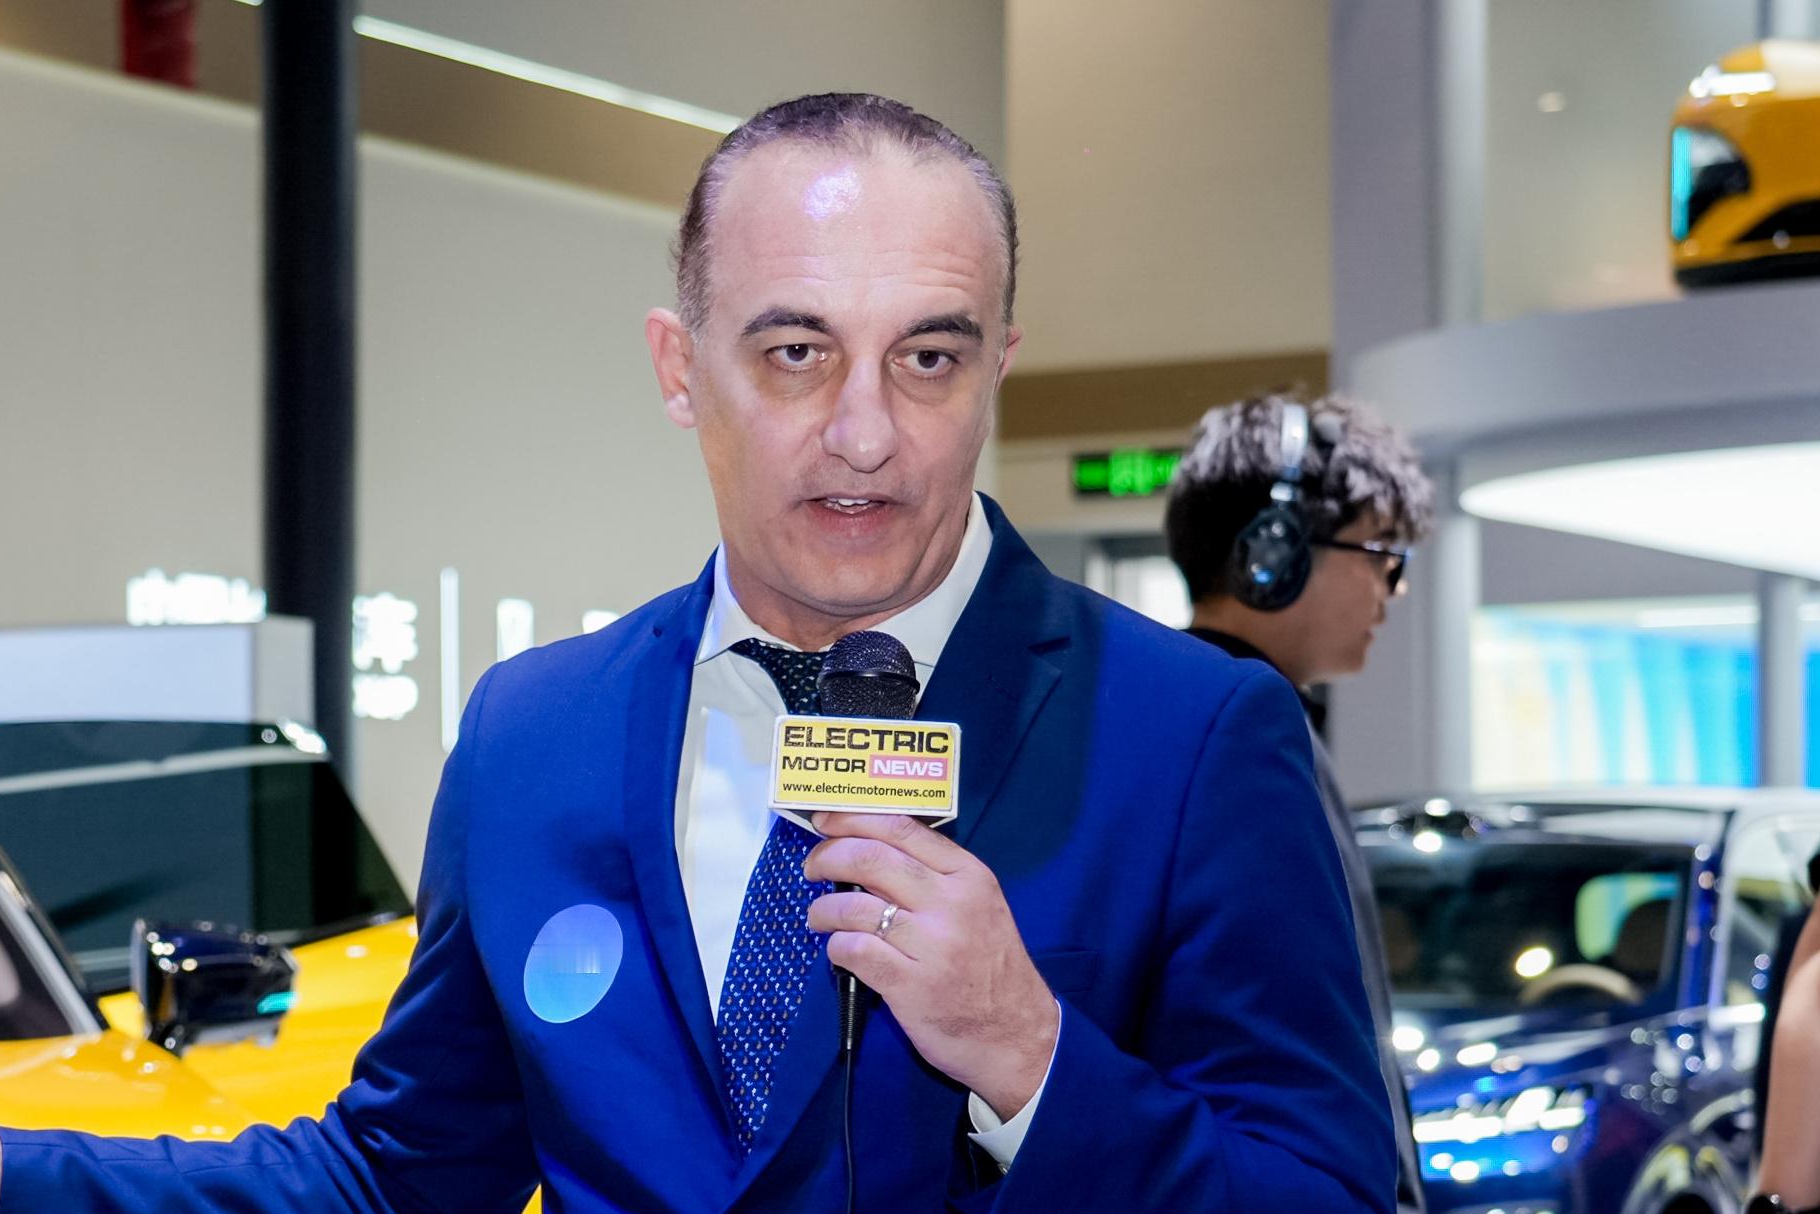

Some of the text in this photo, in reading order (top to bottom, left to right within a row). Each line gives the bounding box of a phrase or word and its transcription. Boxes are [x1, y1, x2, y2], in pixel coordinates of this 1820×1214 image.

[784, 725, 949, 754] ELECTRIC
[782, 756, 944, 777] MOTOR NEWS
[782, 780, 946, 799] www.electricmotornews.com
